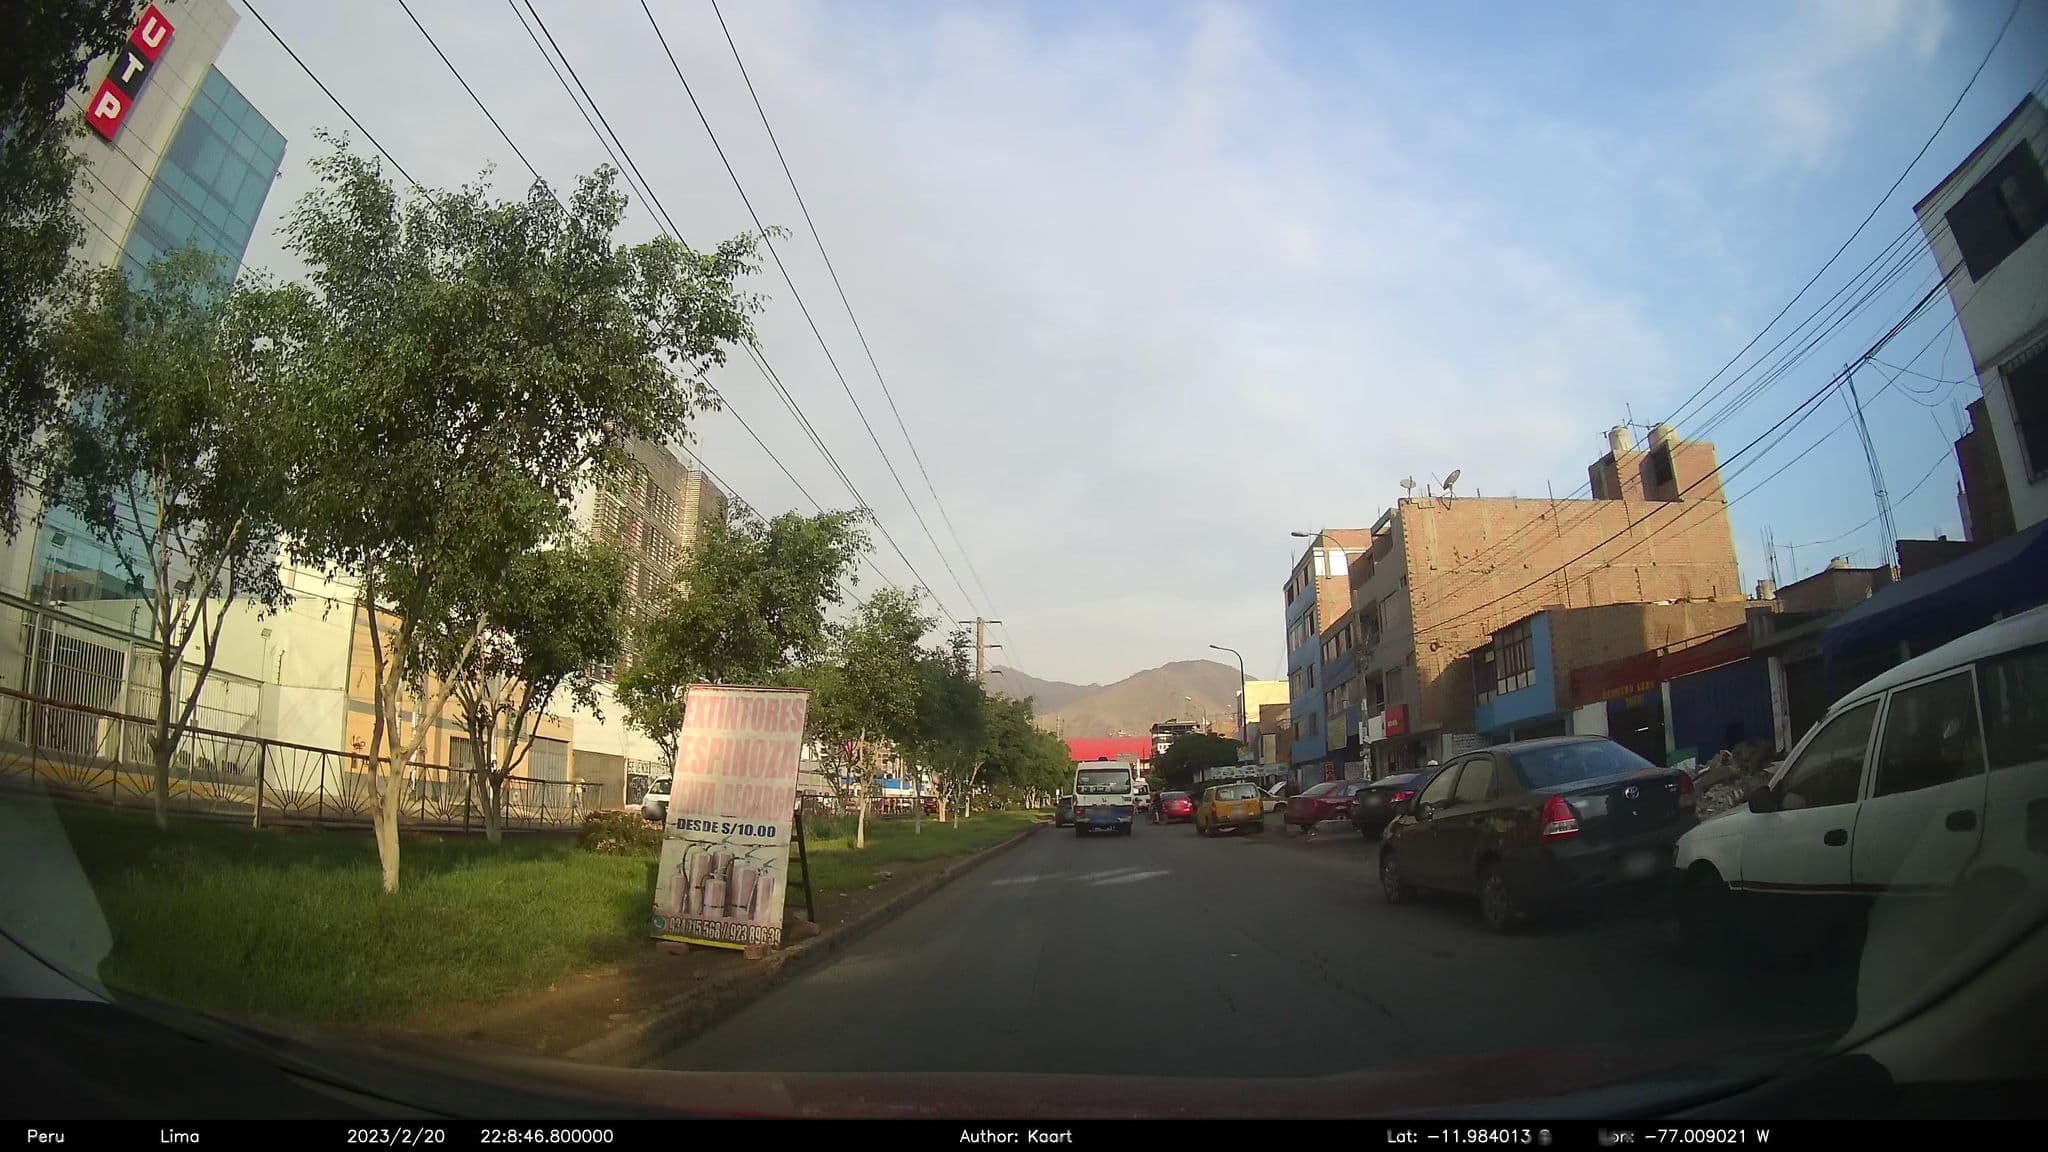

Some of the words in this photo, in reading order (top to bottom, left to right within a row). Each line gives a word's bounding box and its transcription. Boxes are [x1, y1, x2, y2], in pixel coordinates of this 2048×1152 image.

[94, 16, 167, 119] UTP
[682, 695, 804, 732] EXTINTORES
[678, 735, 798, 779] ESPINOZA
[677, 818, 719, 833] DESDE
[721, 822, 776, 838] S/10.00
[730, 923, 748, 942] 923
